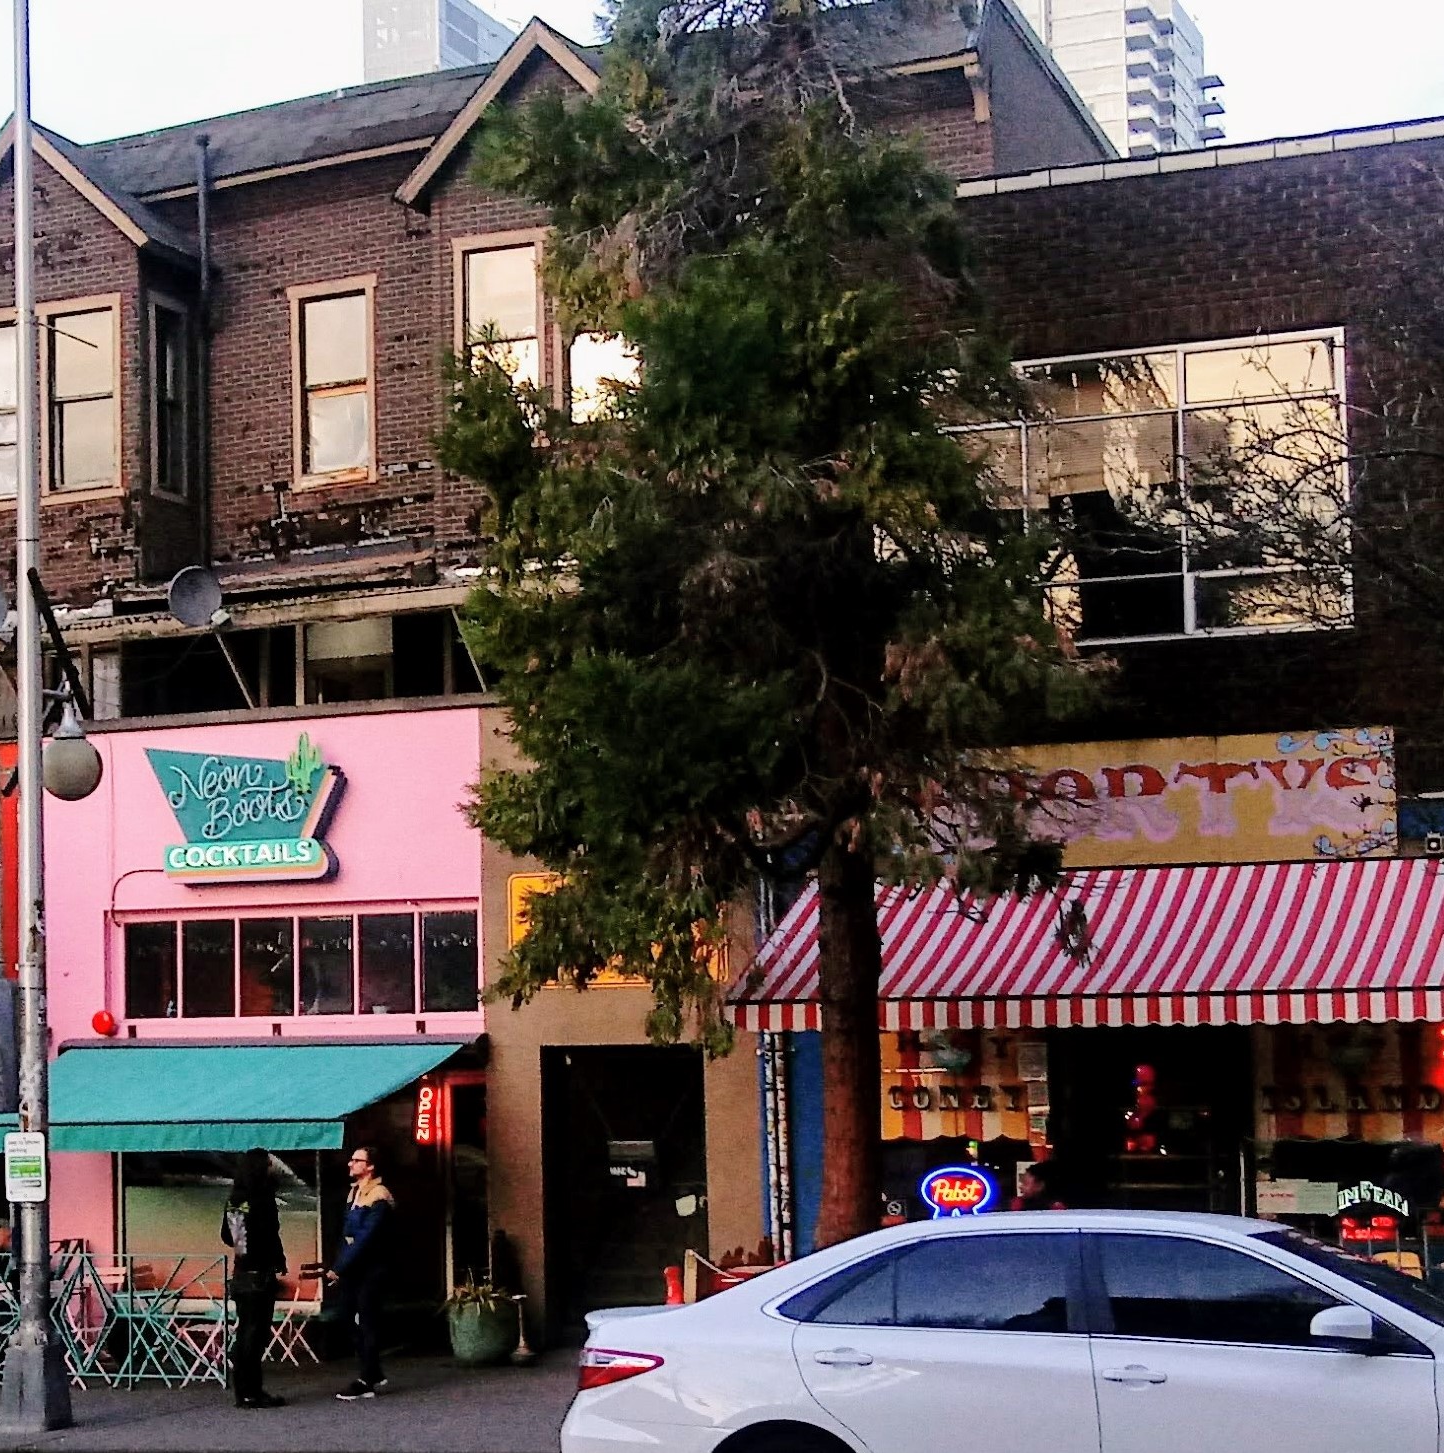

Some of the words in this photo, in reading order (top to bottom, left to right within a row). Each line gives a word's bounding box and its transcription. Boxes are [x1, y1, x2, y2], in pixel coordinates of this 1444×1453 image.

[168, 757, 262, 809] Neon
[201, 779, 305, 840] Boots
[168, 841, 312, 868] COCKTAILS
[417, 1086, 434, 1141] OPEN
[930, 1178, 982, 1204] Pabst
